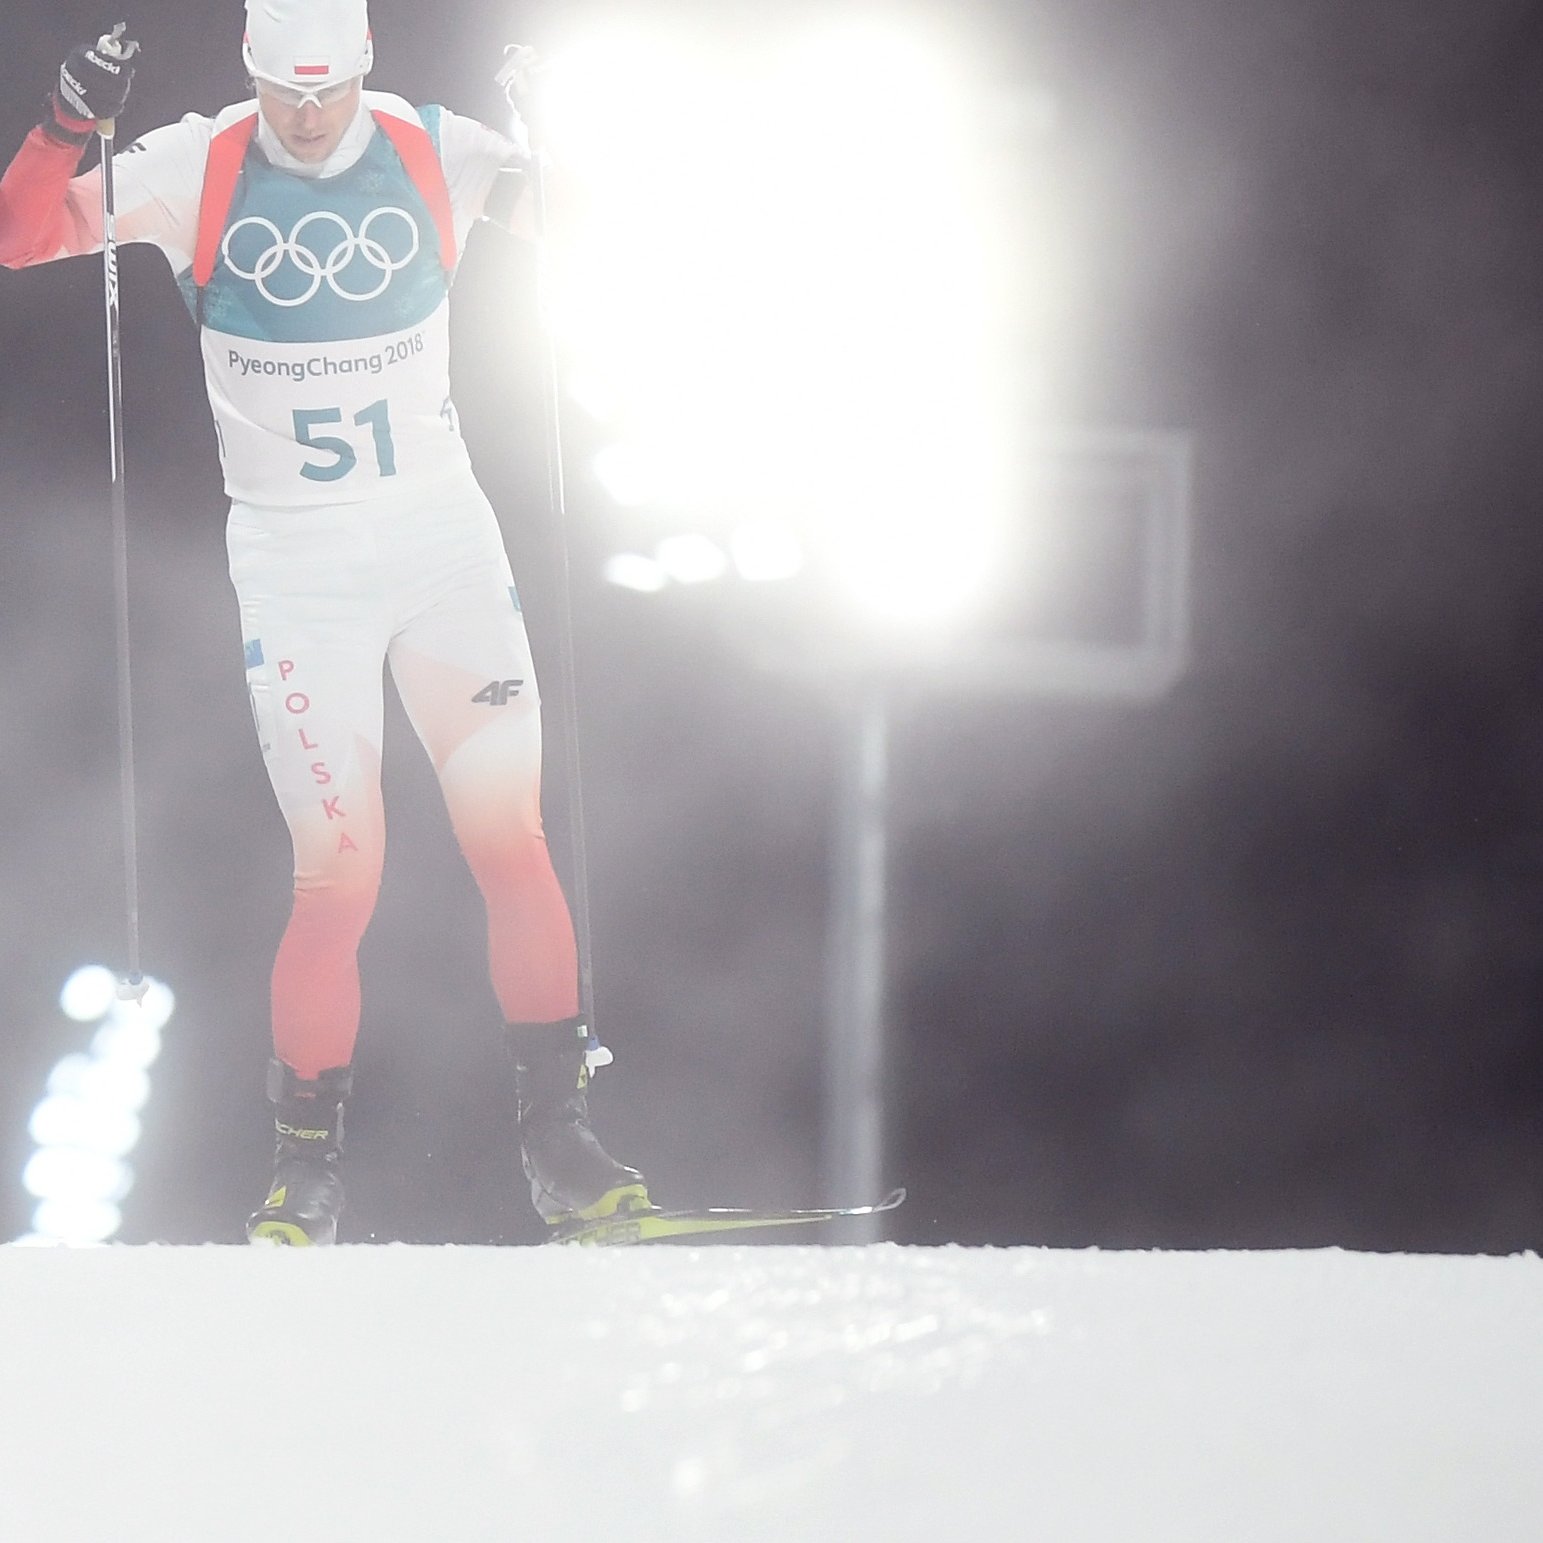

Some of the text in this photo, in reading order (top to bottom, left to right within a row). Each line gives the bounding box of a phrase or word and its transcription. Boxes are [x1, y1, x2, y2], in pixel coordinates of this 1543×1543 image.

[228, 333, 424, 382] PyeongChang 2018
[292, 398, 397, 482] 51
[471, 679, 524, 706] 4F
[277, 659, 359, 855] POLSKA
